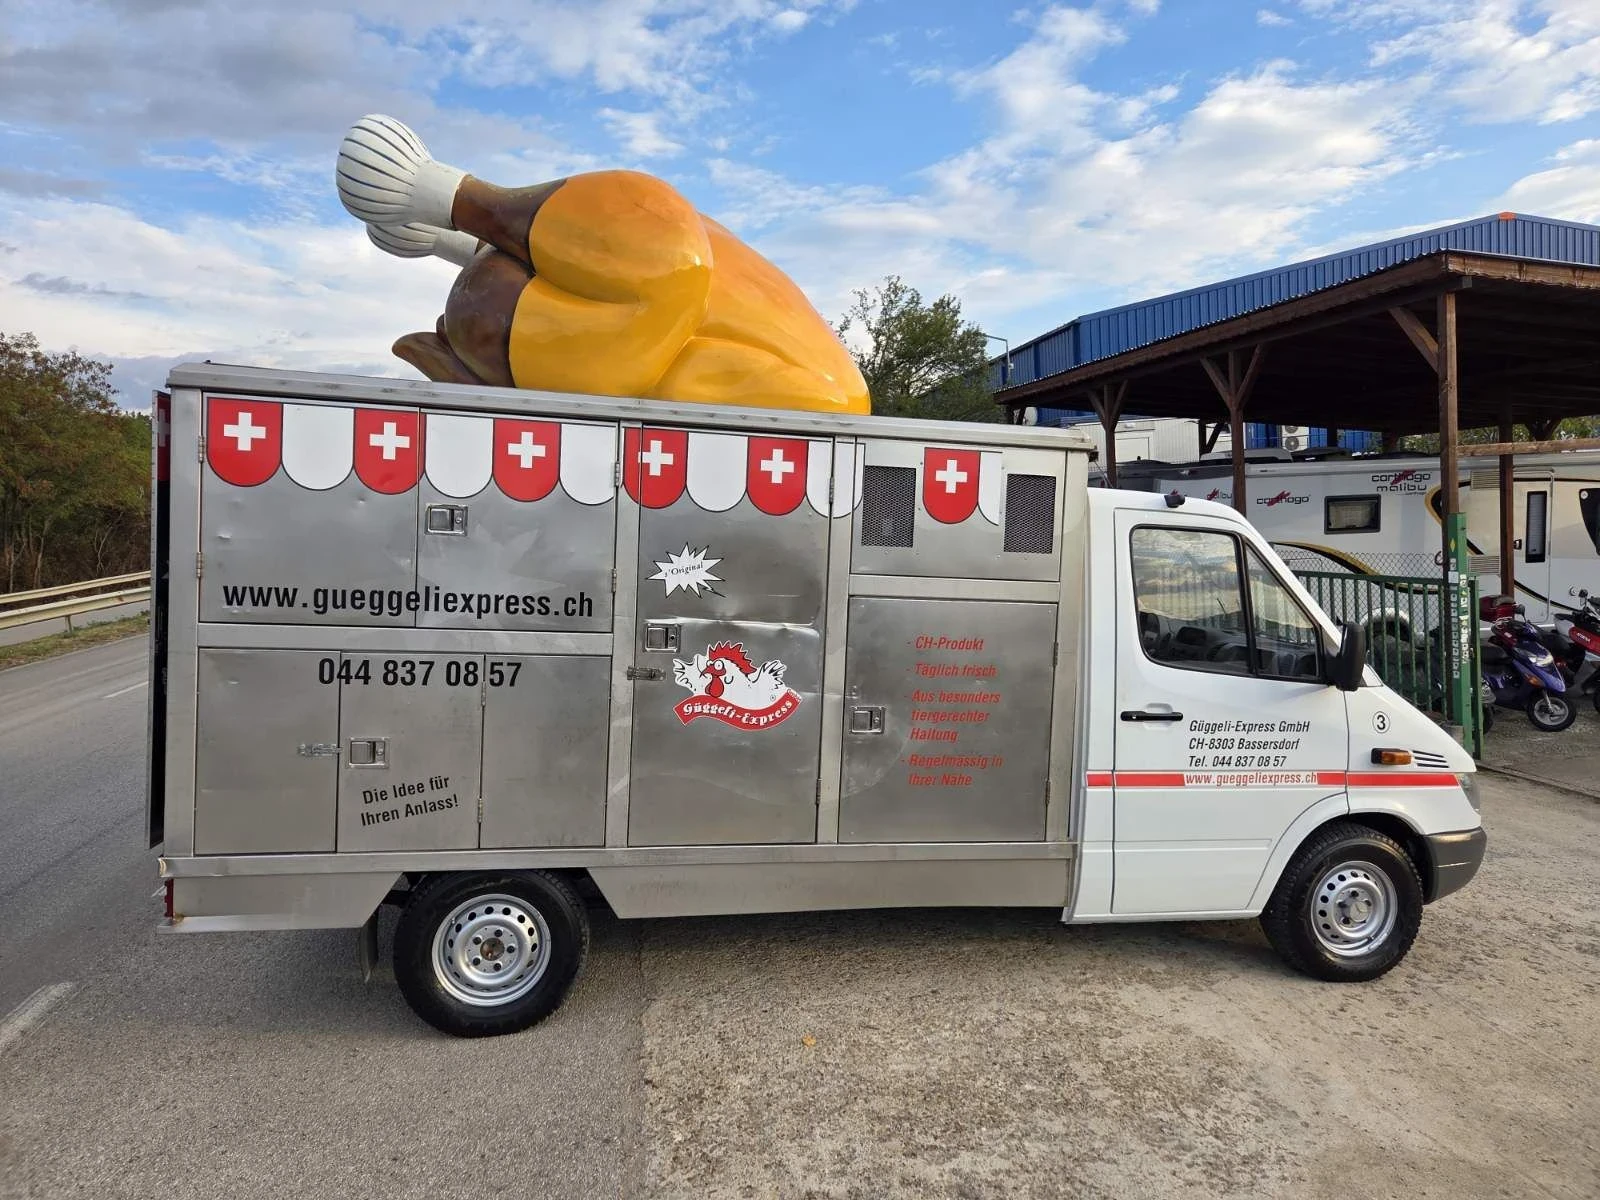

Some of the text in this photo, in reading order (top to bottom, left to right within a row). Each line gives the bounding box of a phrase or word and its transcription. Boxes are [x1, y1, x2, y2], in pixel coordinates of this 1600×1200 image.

[1376, 483, 1427, 492] malibu
[1256, 493, 1310, 505] cahago
[223, 584, 594, 619] www.gueggeliexpress.ch
[915, 636, 985, 651] CH-Produkt
[318, 658, 522, 687] 044 837 08 57
[915, 663, 959, 679] Täglich
[912, 690, 1001, 704] Aus besonders
[682, 699, 793, 726] Güggeli-Express
[911, 709, 990, 723] tiergerechter
[1189, 720, 1311, 734] Güggeli-Express GmbH
[1376, 715, 1387, 731] 3
[1188, 738, 1300, 751] CH-8303 Bassersdorf
[1188, 756, 1288, 768] Tel. 044 837 08 57
[1186, 772, 1318, 787] www.gueggeliexpress.ch
[363, 776, 450, 804] Die Idee für
[361, 794, 459, 826] Ihren Anlass!
